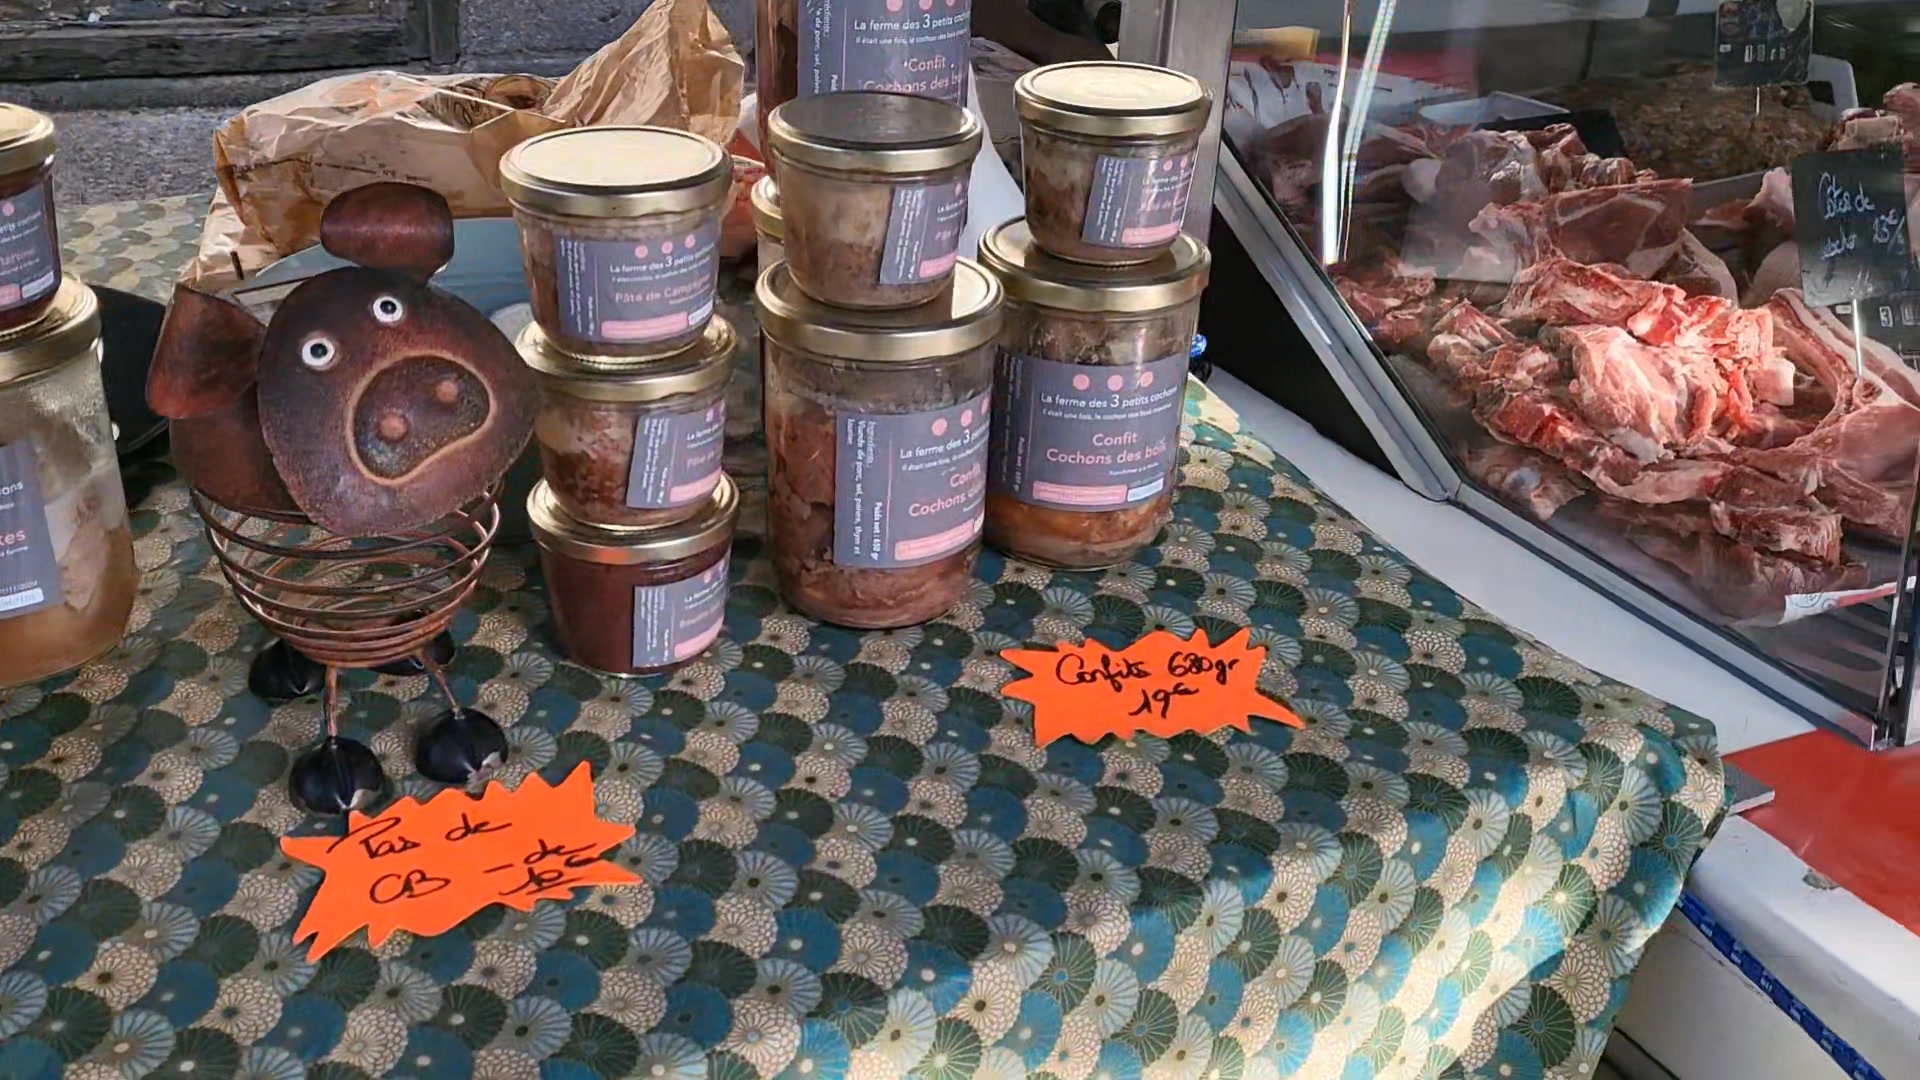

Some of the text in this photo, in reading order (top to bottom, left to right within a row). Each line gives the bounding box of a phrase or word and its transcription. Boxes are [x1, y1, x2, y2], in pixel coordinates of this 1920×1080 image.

[854, 19, 866, 30] La
[870, 19, 899, 30] ferme
[902, 19, 920, 30] des
[922, 14, 930, 28] 3
[909, 55, 946, 72] Confit
[930, 75, 949, 90] des
[610, 264, 620, 273] La
[665, 255, 673, 267] 3
[646, 290, 661, 301] de
[1040, 392, 1053, 403] La
[1055, 394, 1086, 408] ferme
[1089, 398, 1107, 408] des
[1110, 394, 1120, 408] 3
[1121, 394, 1149, 409] petits
[900, 448, 912, 459] La
[915, 445, 945, 457] ferme
[946, 439, 961, 450] des
[963, 429, 971, 444] 3
[1092, 431, 1138, 447] Confit
[1046, 448, 1112, 465] Cochons
[1117, 449, 1142, 464] des
[908, 493, 966, 517] Cochons
[445, 812, 513, 842] de
[369, 869, 451, 904] CB
[523, 838, 597, 865] de
